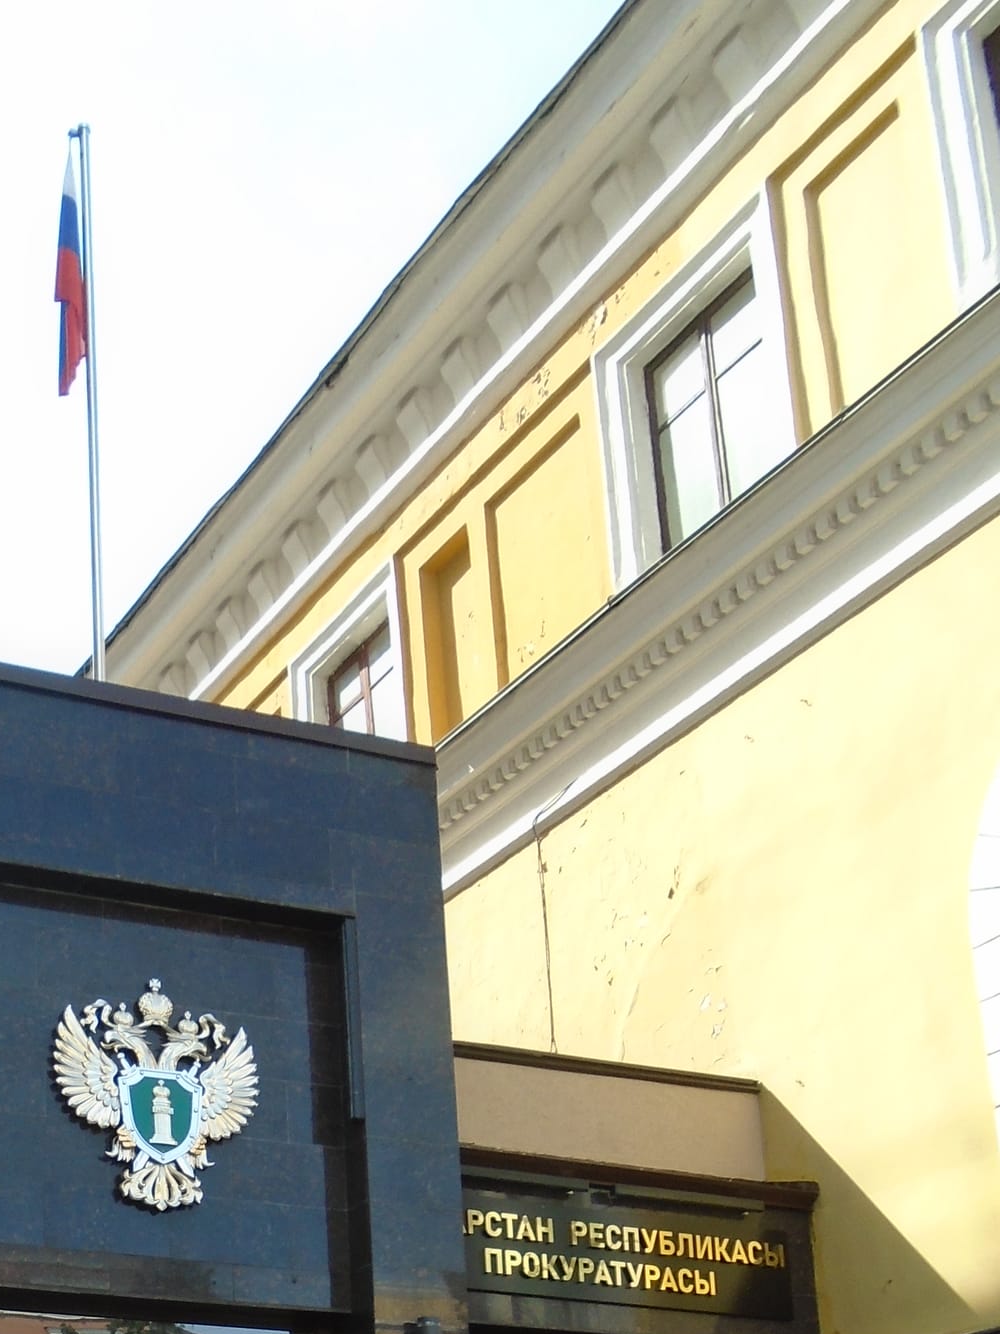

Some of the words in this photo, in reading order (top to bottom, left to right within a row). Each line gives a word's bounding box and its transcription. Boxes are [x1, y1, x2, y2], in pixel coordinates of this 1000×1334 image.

[462, 1208, 555, 1244] РСТАН
[570, 1220, 785, 1269] РЕСПУБЛИКАСЫ
[484, 1247, 718, 1296] ПРОКУРАТУРАСЫ
